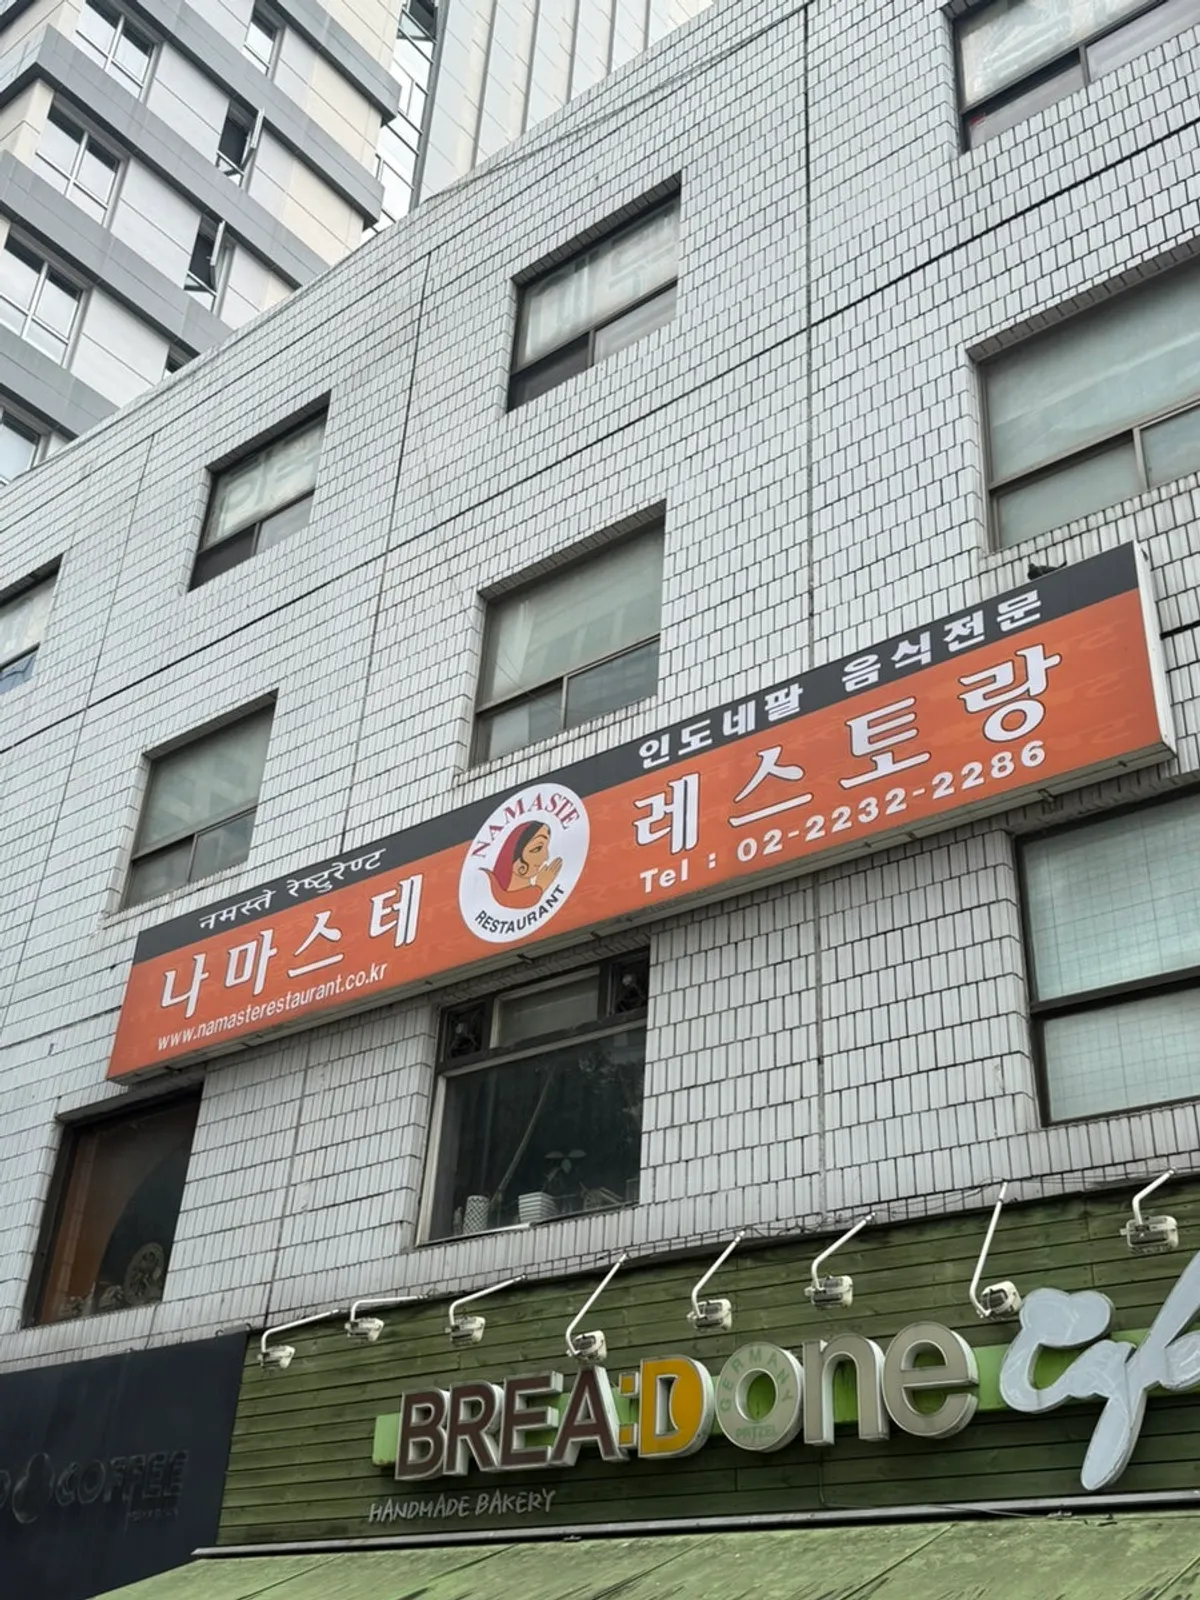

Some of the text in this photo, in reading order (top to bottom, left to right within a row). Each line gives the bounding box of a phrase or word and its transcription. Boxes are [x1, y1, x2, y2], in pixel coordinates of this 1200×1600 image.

[638, 589, 1042, 770] 인도네팔 음식전문
[160, 643, 1062, 1019] 나마스테 레스토랑
[471, 792, 581, 858] NAMASTE
[736, 740, 1047, 864] 02-2232-2286
[199, 889, 277, 930] नमस्ते
[474, 884, 566, 935] RESTAURANT
[157, 962, 388, 1051] www.namasterestaurant.co.kr
[719, 1348, 794, 1412] GERMANY
[55, 1450, 190, 1507] COFFEE
[367, 1488, 557, 1523] HANDMADE BAKERY
